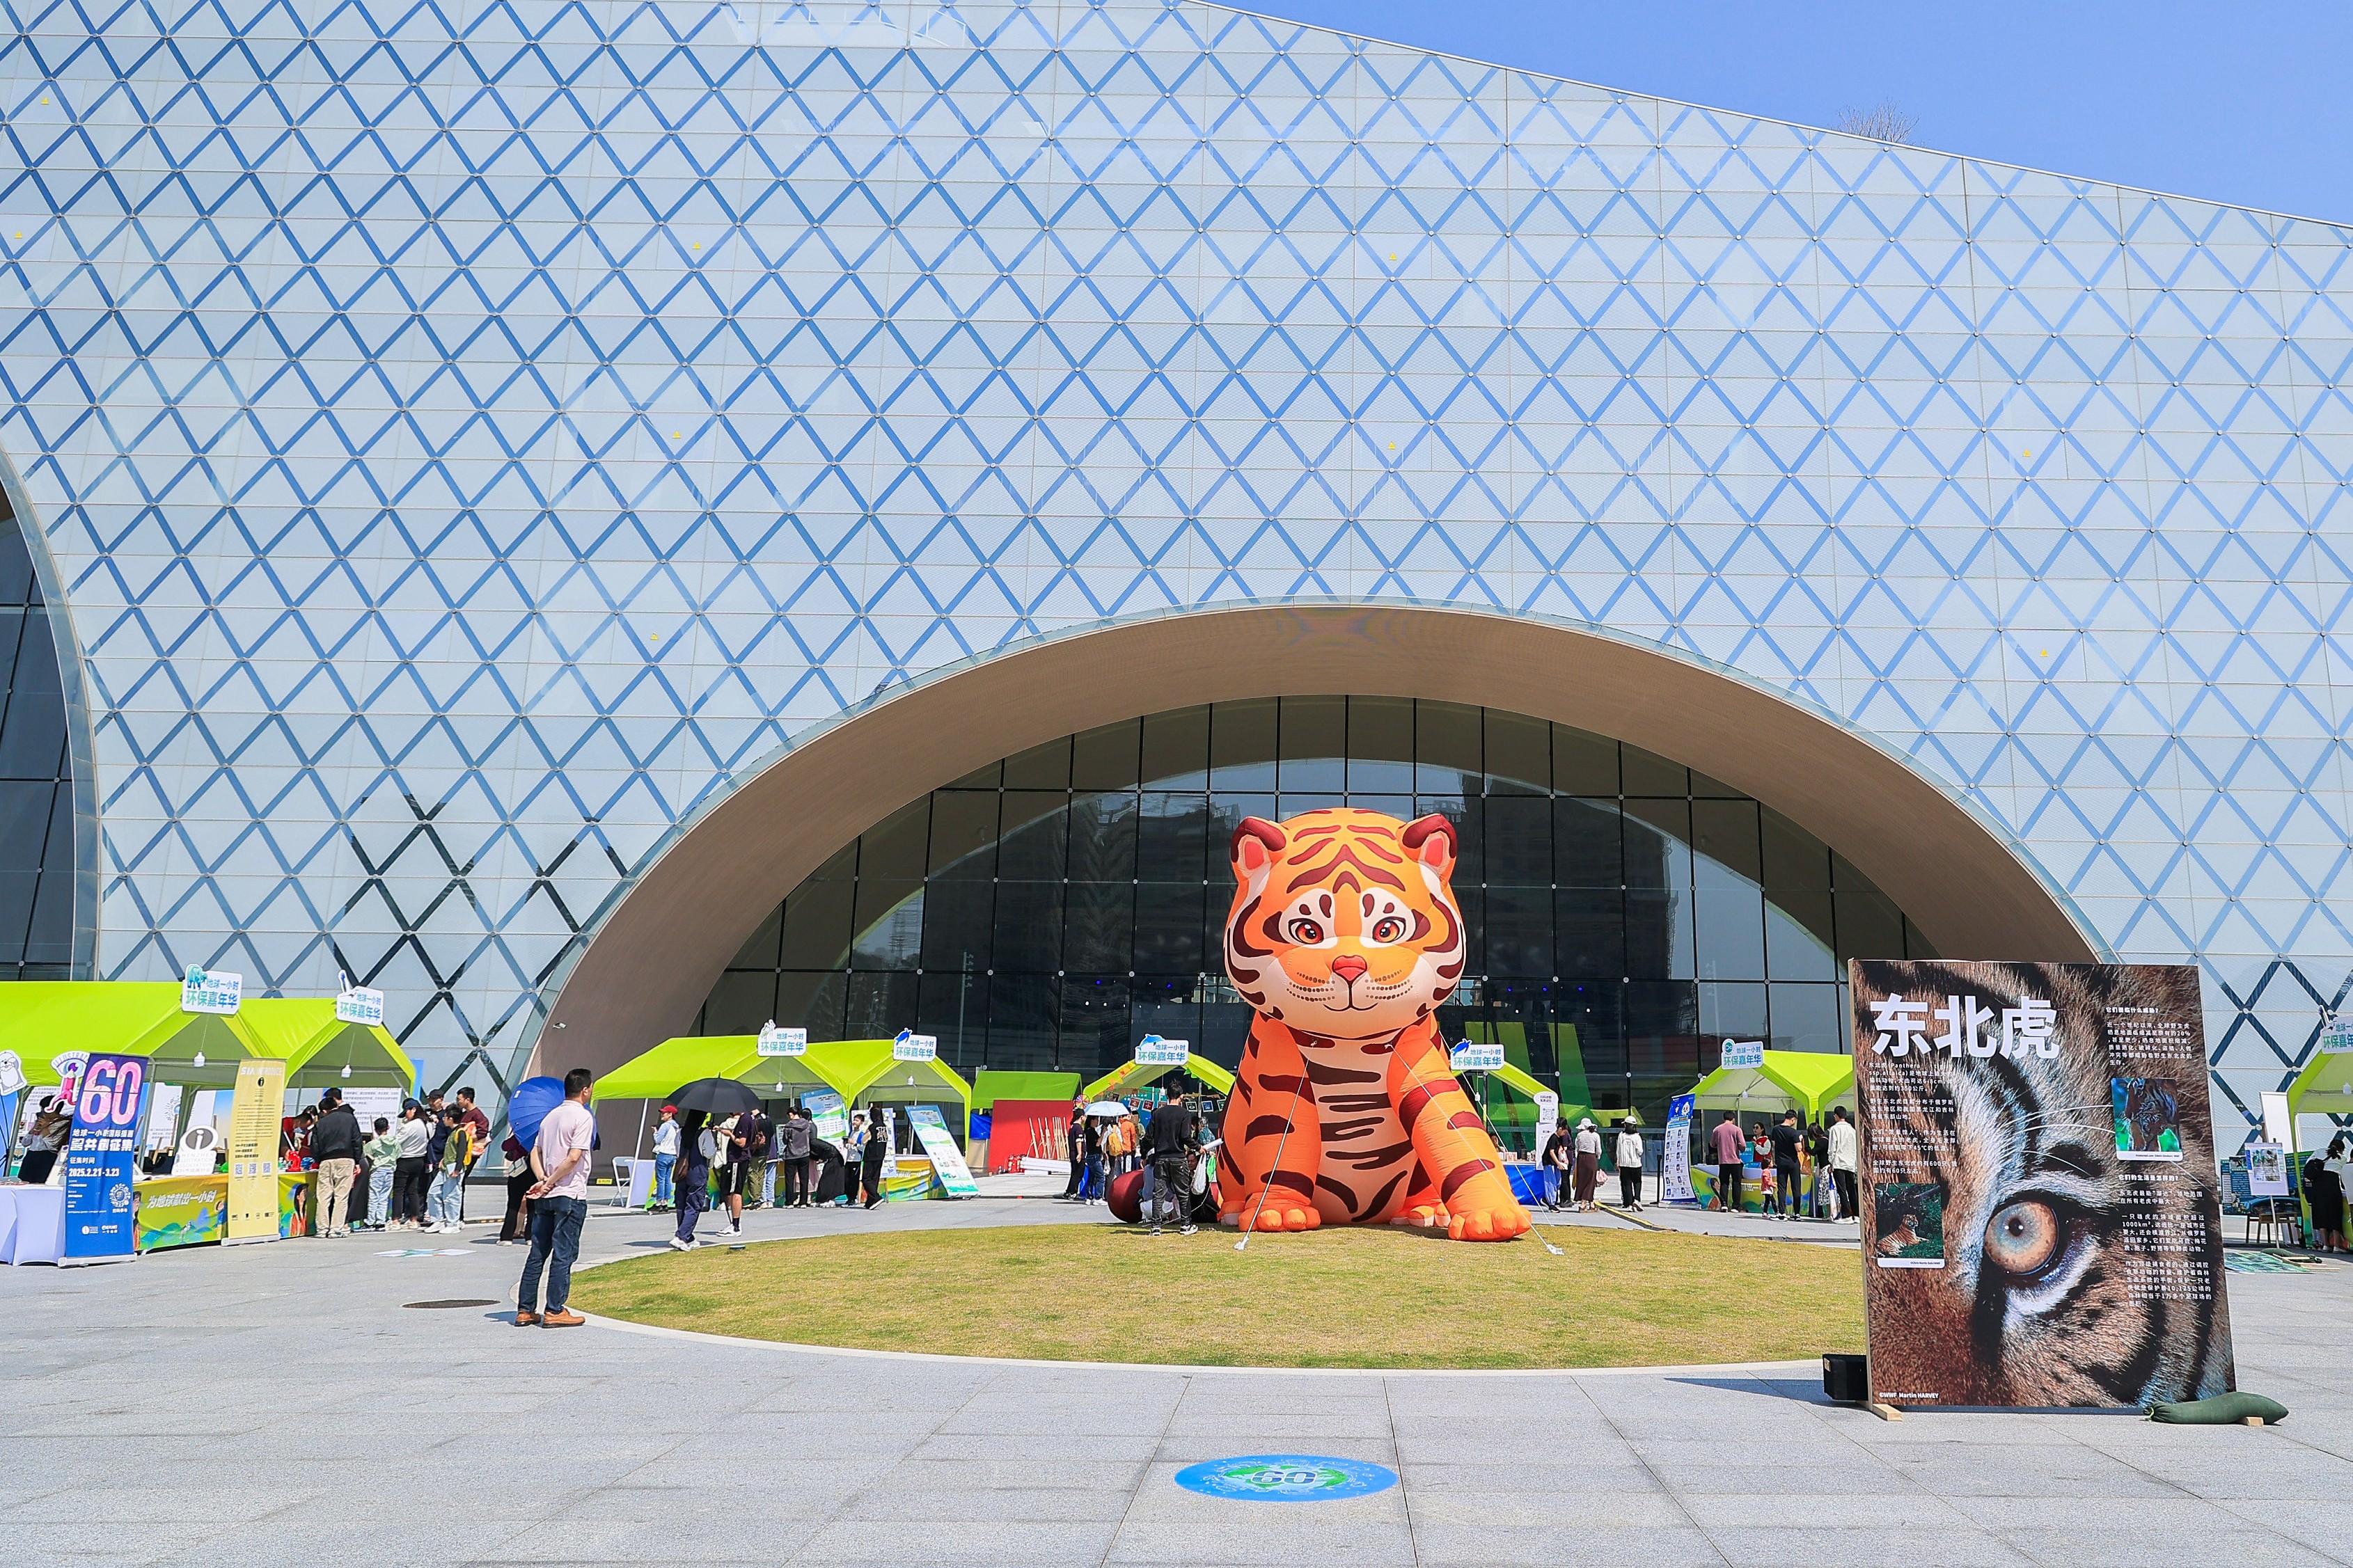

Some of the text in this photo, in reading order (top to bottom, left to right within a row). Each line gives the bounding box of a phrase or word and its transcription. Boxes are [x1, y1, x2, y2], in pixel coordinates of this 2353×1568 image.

[206, 979, 239, 990] 地球一小时
[186, 990, 237, 1008] 环保嘉年华
[356, 993, 381, 1006] 地球一小时
[340, 1001, 380, 1020] 环保嘉年华
[1871, 994, 2059, 1060] 东北虎
[2336, 1023, 2353, 1031] 地球一
[761, 1041, 804, 1052] 环保嘉年华
[896, 1047, 934, 1058] 环保嘉年华
[1138, 1052, 1185, 1061] 环保嘉年华
[1454, 1056, 1502, 1066] 环保嘉年华
[1724, 1054, 1761, 1066] 环保嘉年华
[79, 1060, 142, 1125] 60
[147, 1190, 217, 1208] 为地球献出一小时
[1251, 1471, 1317, 1484] 60
